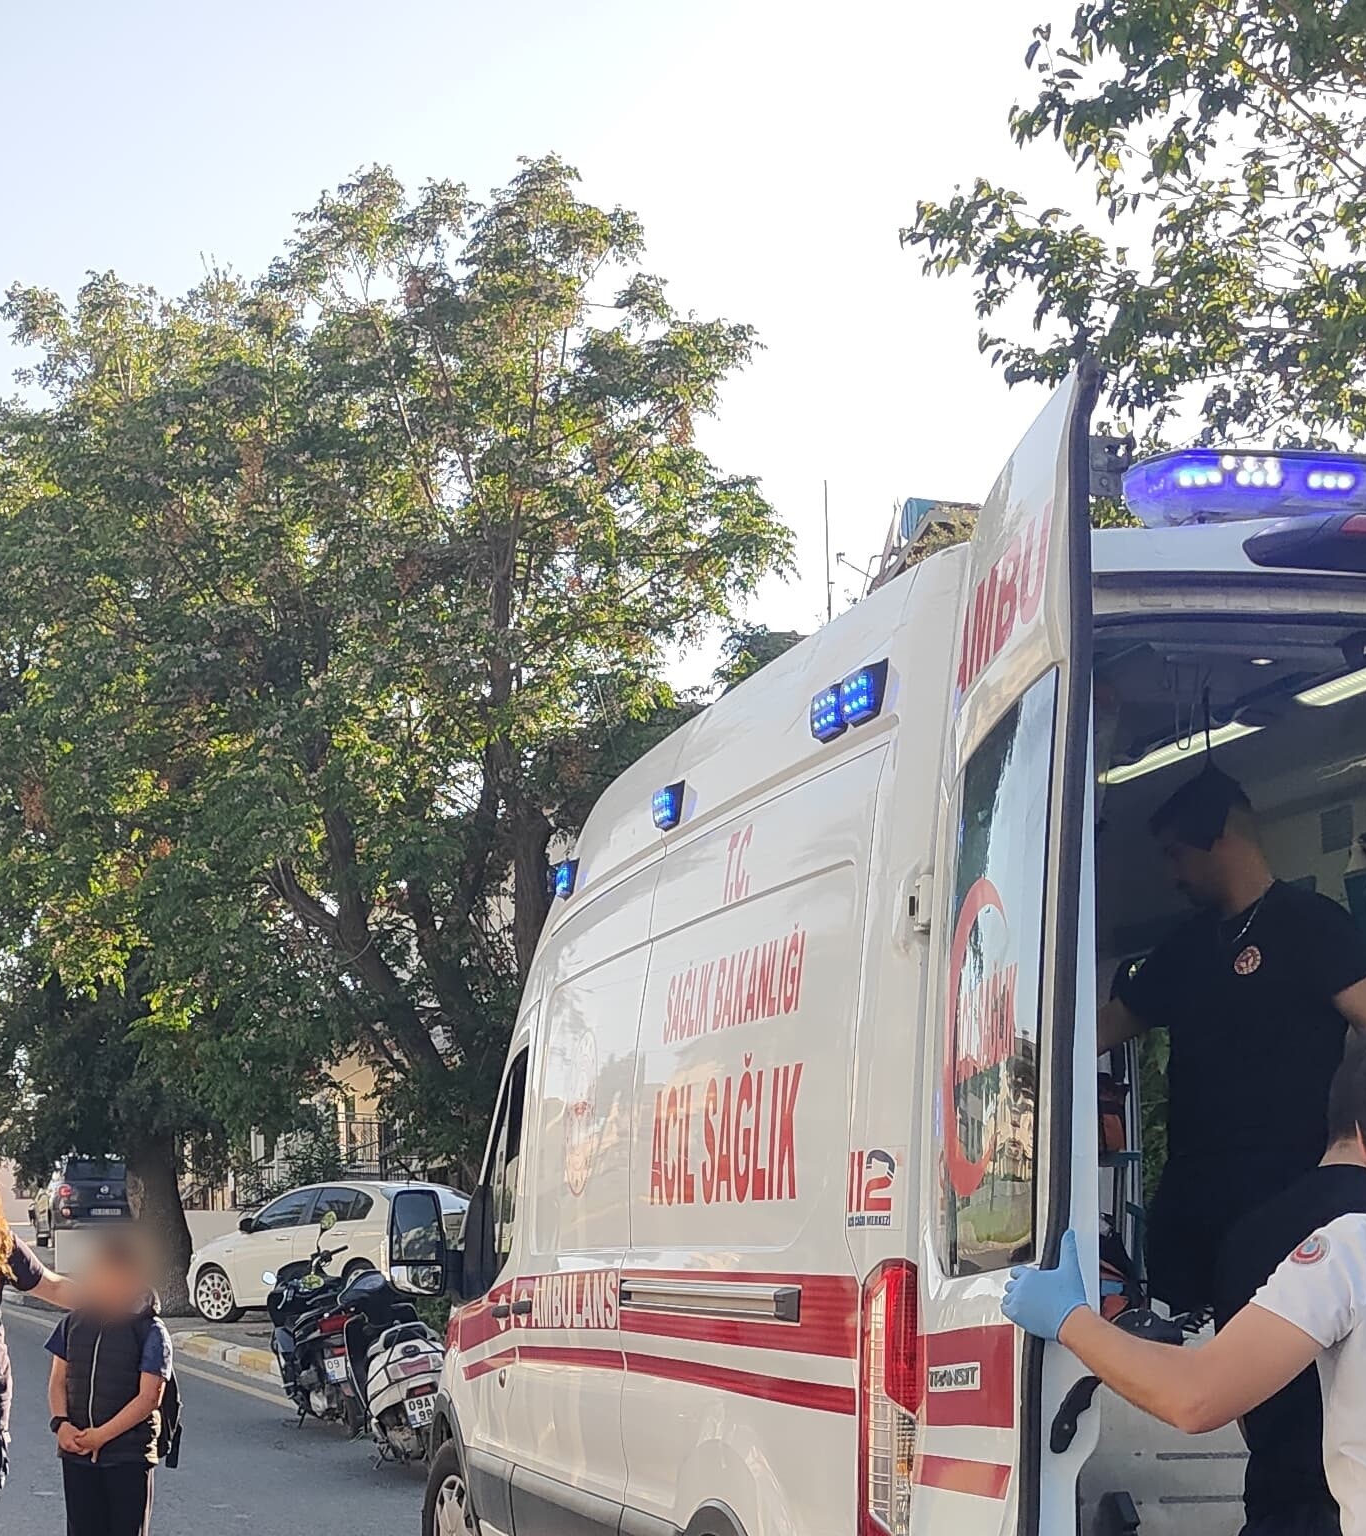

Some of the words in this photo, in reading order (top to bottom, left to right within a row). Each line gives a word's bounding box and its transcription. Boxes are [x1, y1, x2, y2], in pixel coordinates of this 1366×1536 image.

[663, 961, 715, 1045] SAĞLIK
[712, 921, 806, 1031] BAKANLIĞI
[650, 1084, 695, 1207] ACİL
[701, 1052, 803, 1206] SAĞLIK
[848, 1149, 895, 1213] 112
[532, 1271, 617, 1329] AMBULANS
